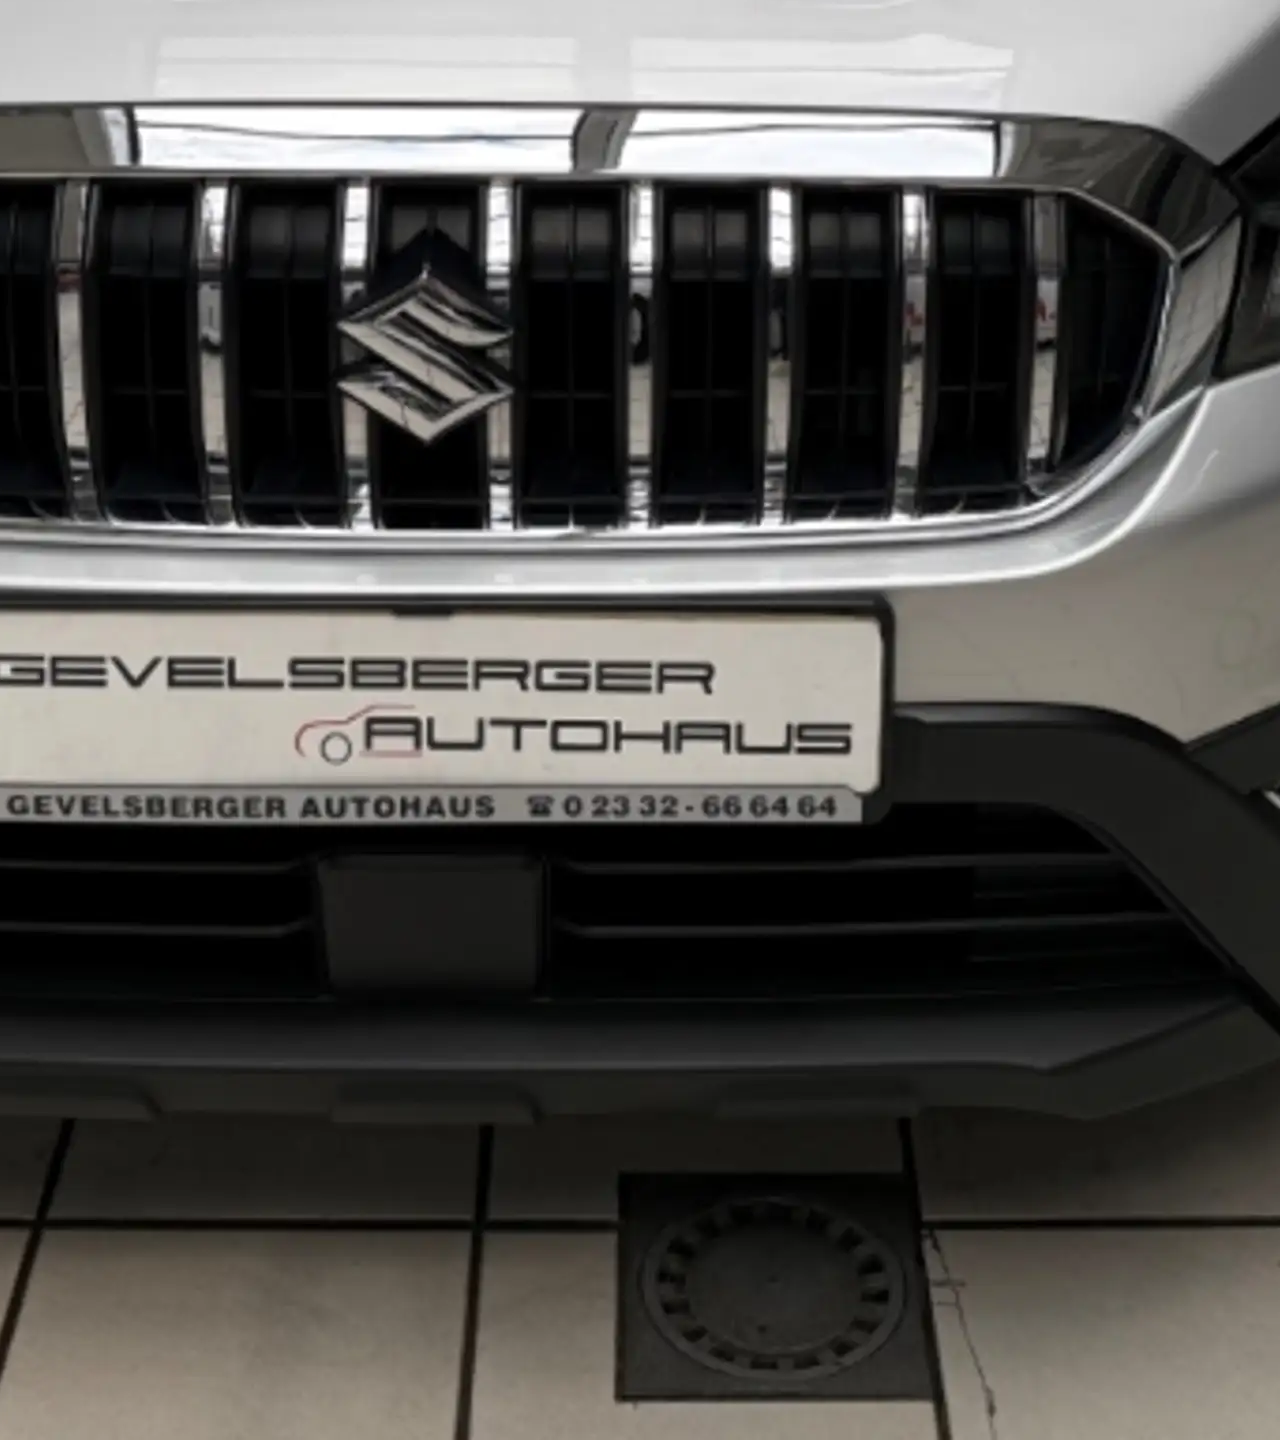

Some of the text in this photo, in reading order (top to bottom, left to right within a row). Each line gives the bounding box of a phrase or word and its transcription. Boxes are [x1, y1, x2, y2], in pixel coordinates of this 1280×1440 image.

[365, 716, 853, 756] AUTOHAUS
[7, 795, 287, 818] GEVELSBERGER
[299, 795, 495, 818] AUTOHAUS
